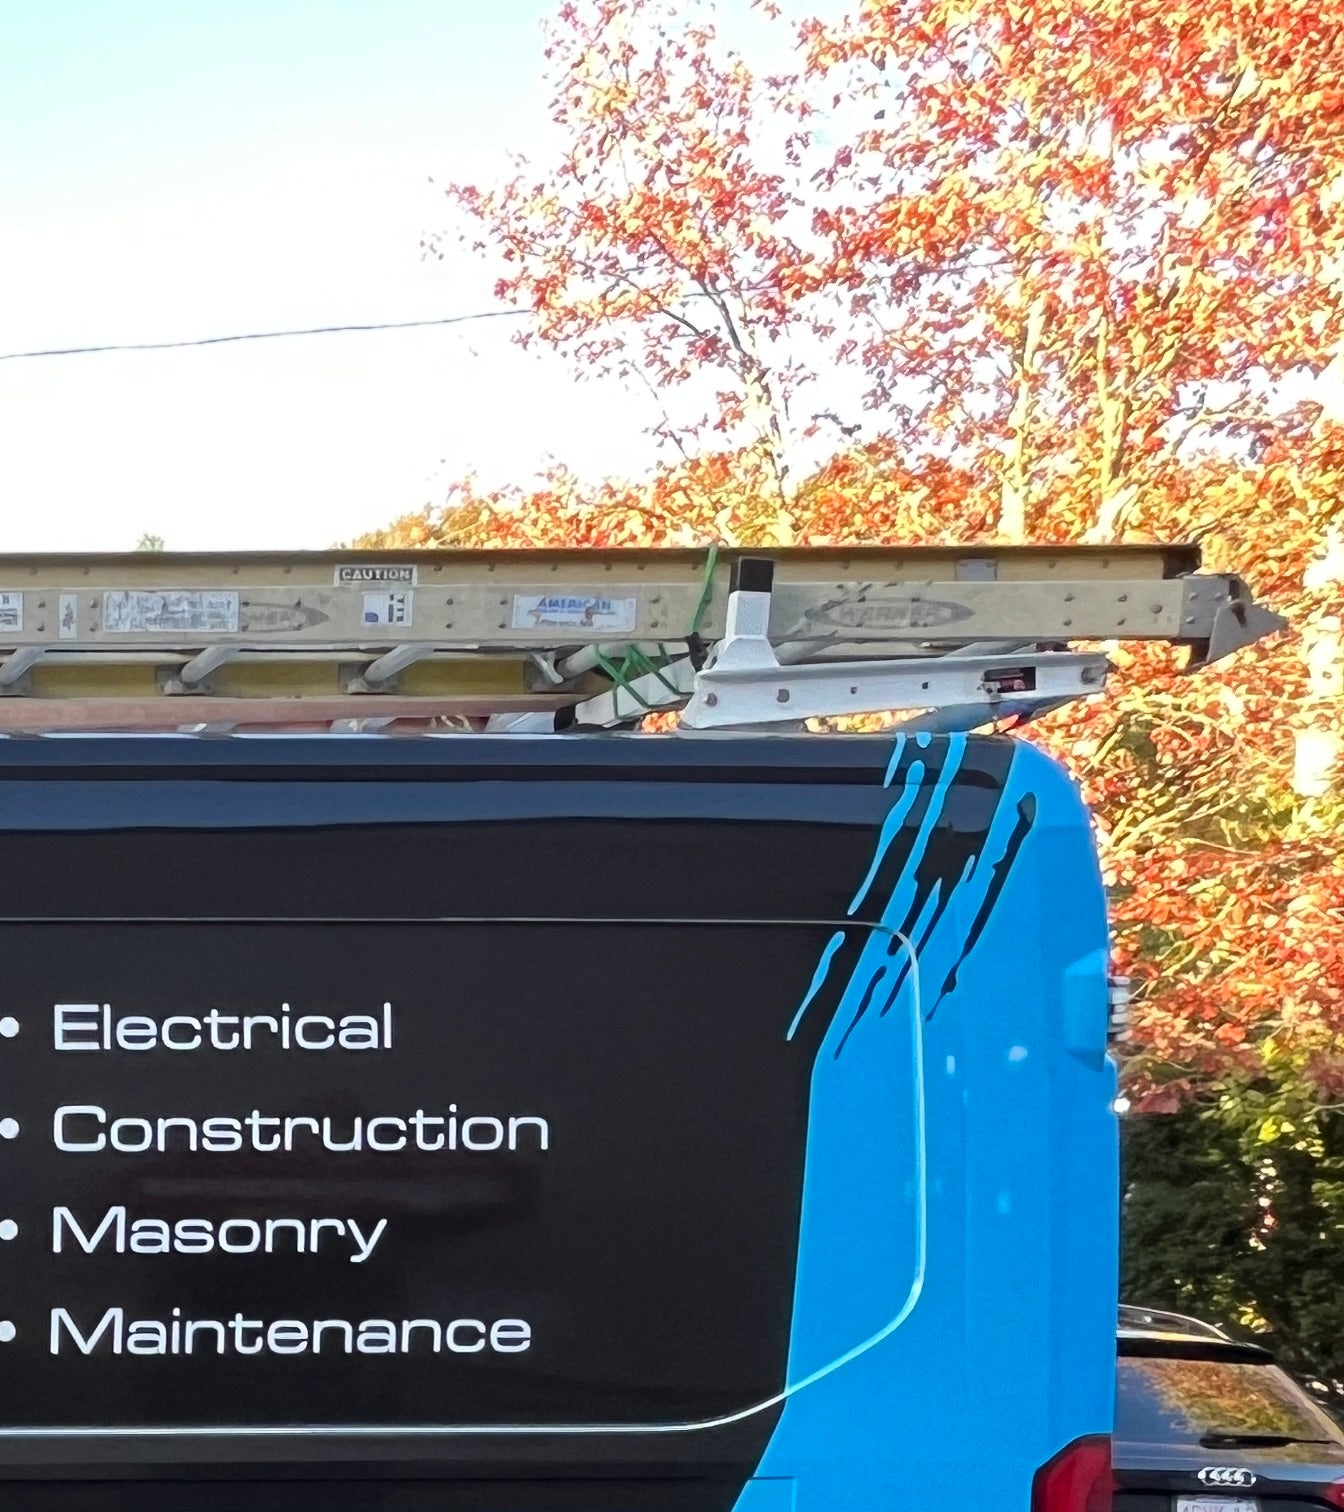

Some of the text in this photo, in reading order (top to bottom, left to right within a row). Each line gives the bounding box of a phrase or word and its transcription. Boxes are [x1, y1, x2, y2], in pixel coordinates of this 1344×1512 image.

[341, 568, 411, 580] CAUTION
[53, 1002, 392, 1051] Electrical
[53, 1103, 550, 1153] Construction
[52, 1205, 388, 1263] Masonry
[49, 1307, 532, 1355] Maintenance
